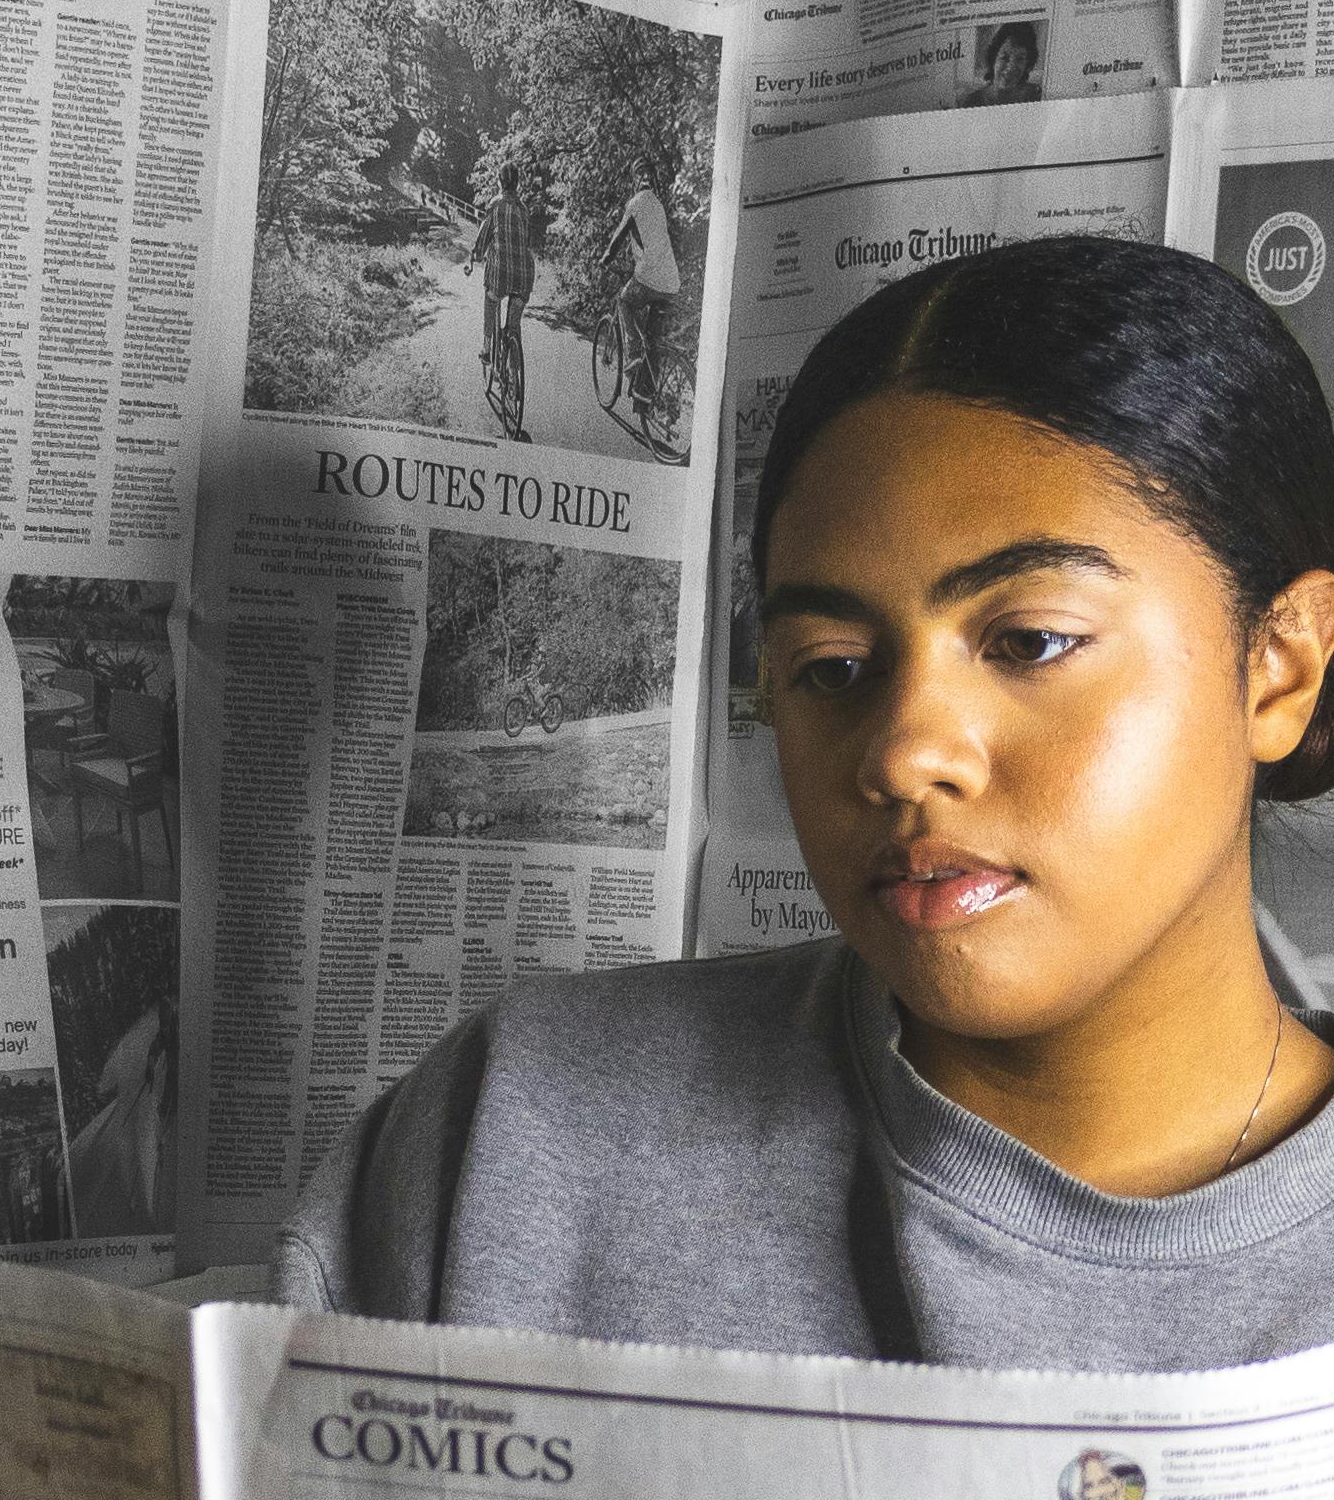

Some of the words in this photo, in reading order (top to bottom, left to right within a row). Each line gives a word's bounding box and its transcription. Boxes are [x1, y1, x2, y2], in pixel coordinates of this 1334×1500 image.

[1264, 246, 1308, 271] JUST
[309, 449, 486, 516] ROUTES
[495, 472, 543, 519] TO
[550, 481, 632, 534] RIDE
[310, 1418, 575, 1485] COMICS
